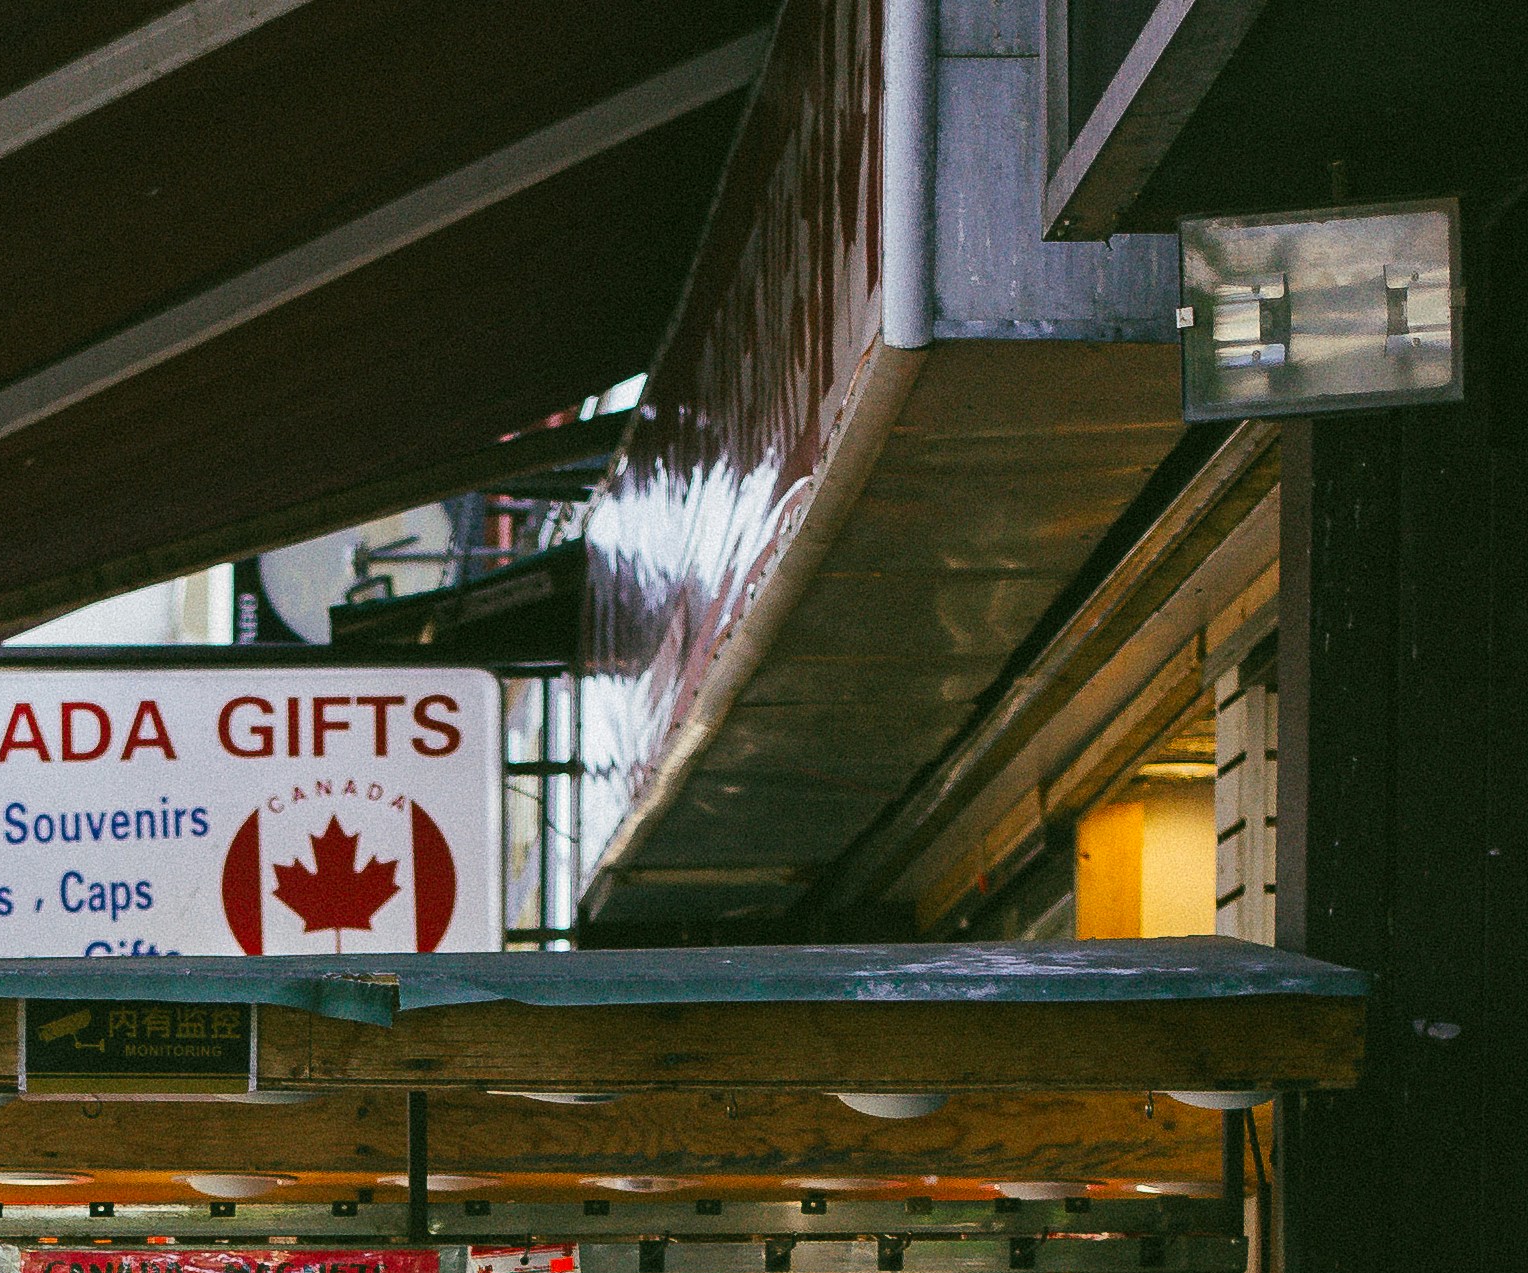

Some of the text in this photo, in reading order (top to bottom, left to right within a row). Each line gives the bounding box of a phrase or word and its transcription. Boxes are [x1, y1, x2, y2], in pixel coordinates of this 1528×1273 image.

[217, 694, 463, 758] GIFTS
[4, 796, 210, 845] Souvenirs
[266, 778, 408, 814] CANADA
[59, 870, 154, 921] Caps
[124, 1044, 222, 1057] MONITORING
